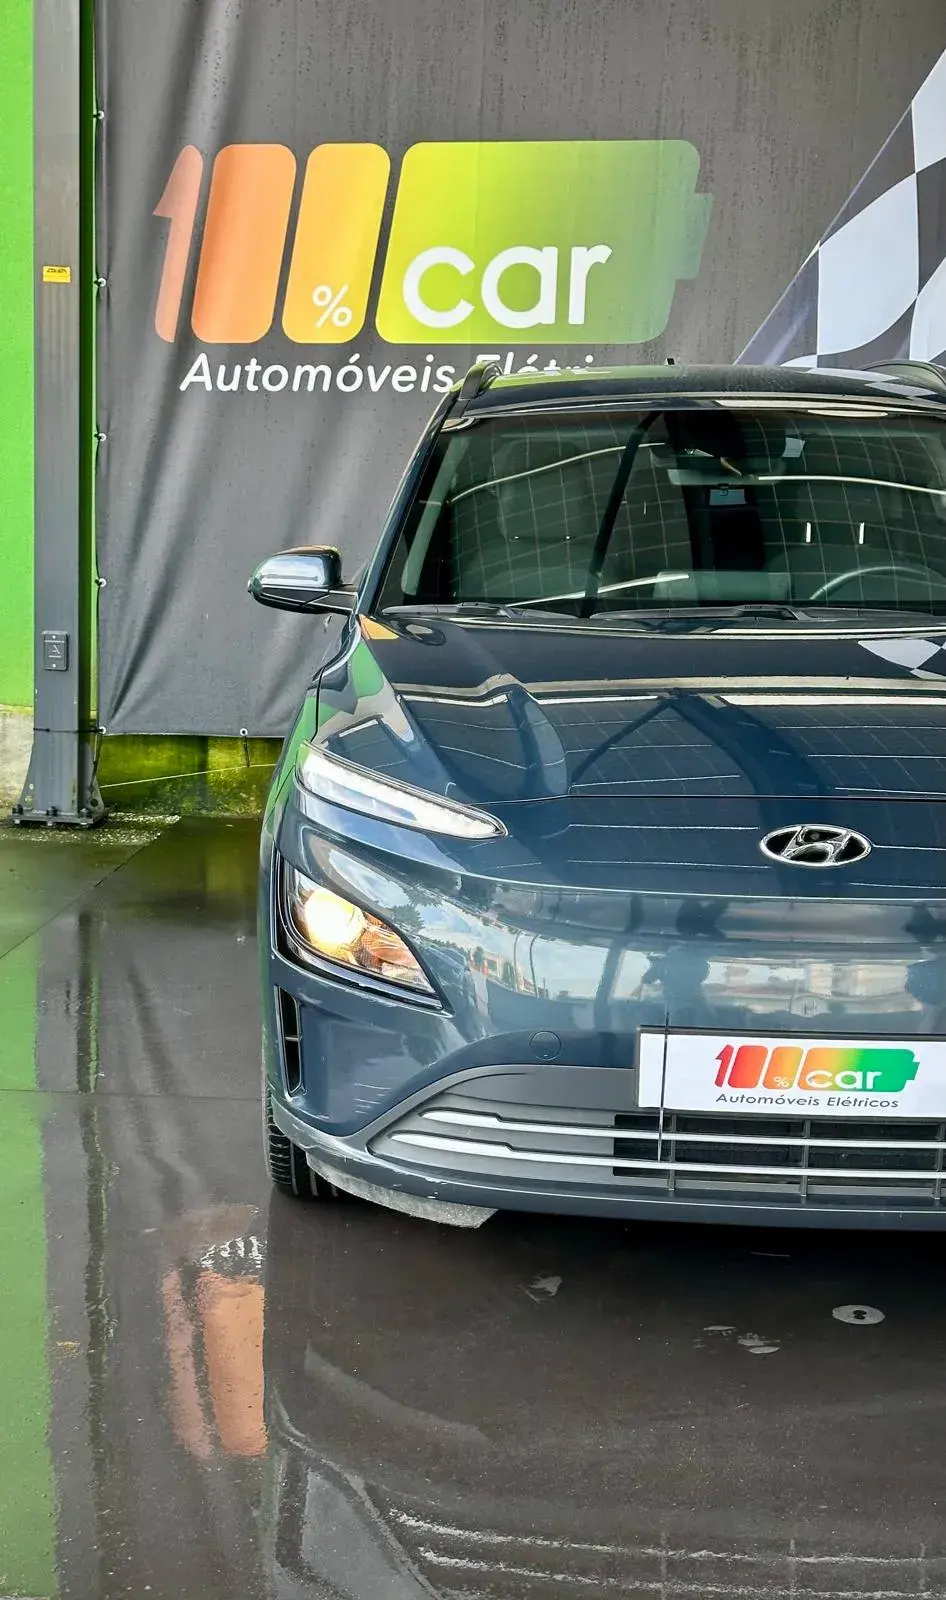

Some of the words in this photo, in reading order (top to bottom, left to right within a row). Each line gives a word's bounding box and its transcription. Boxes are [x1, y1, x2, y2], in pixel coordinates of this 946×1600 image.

[402, 245, 613, 329] car
[180, 352, 456, 394] Automóveis
[806, 1069, 882, 1090] car
[715, 1093, 820, 1106] Automóveis
[826, 1096, 899, 1108] Elétricos
